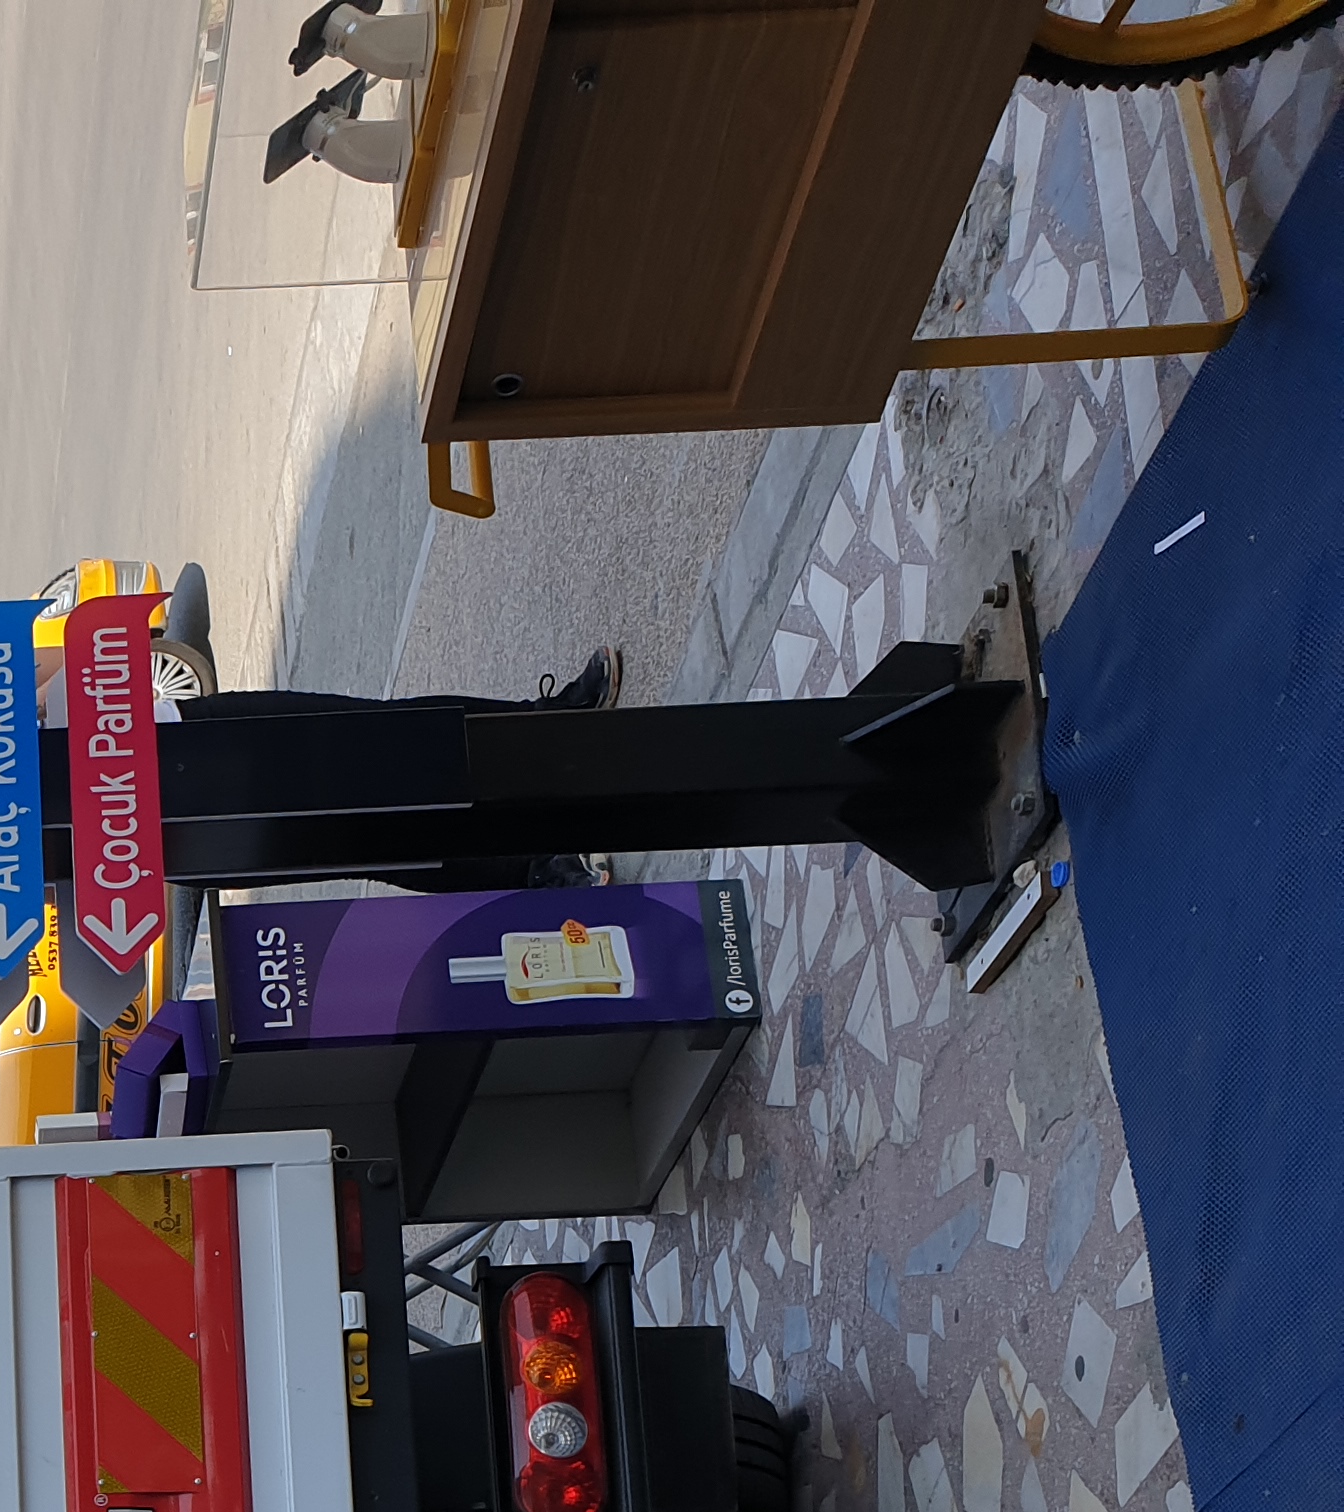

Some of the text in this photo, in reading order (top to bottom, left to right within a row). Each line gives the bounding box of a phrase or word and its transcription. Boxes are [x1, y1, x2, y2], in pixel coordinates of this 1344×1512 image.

[81, 627, 154, 890] Çocuk Parfüm
[254, 926, 294, 1029] LORIS
[292, 941, 309, 1007] PARFÜM
